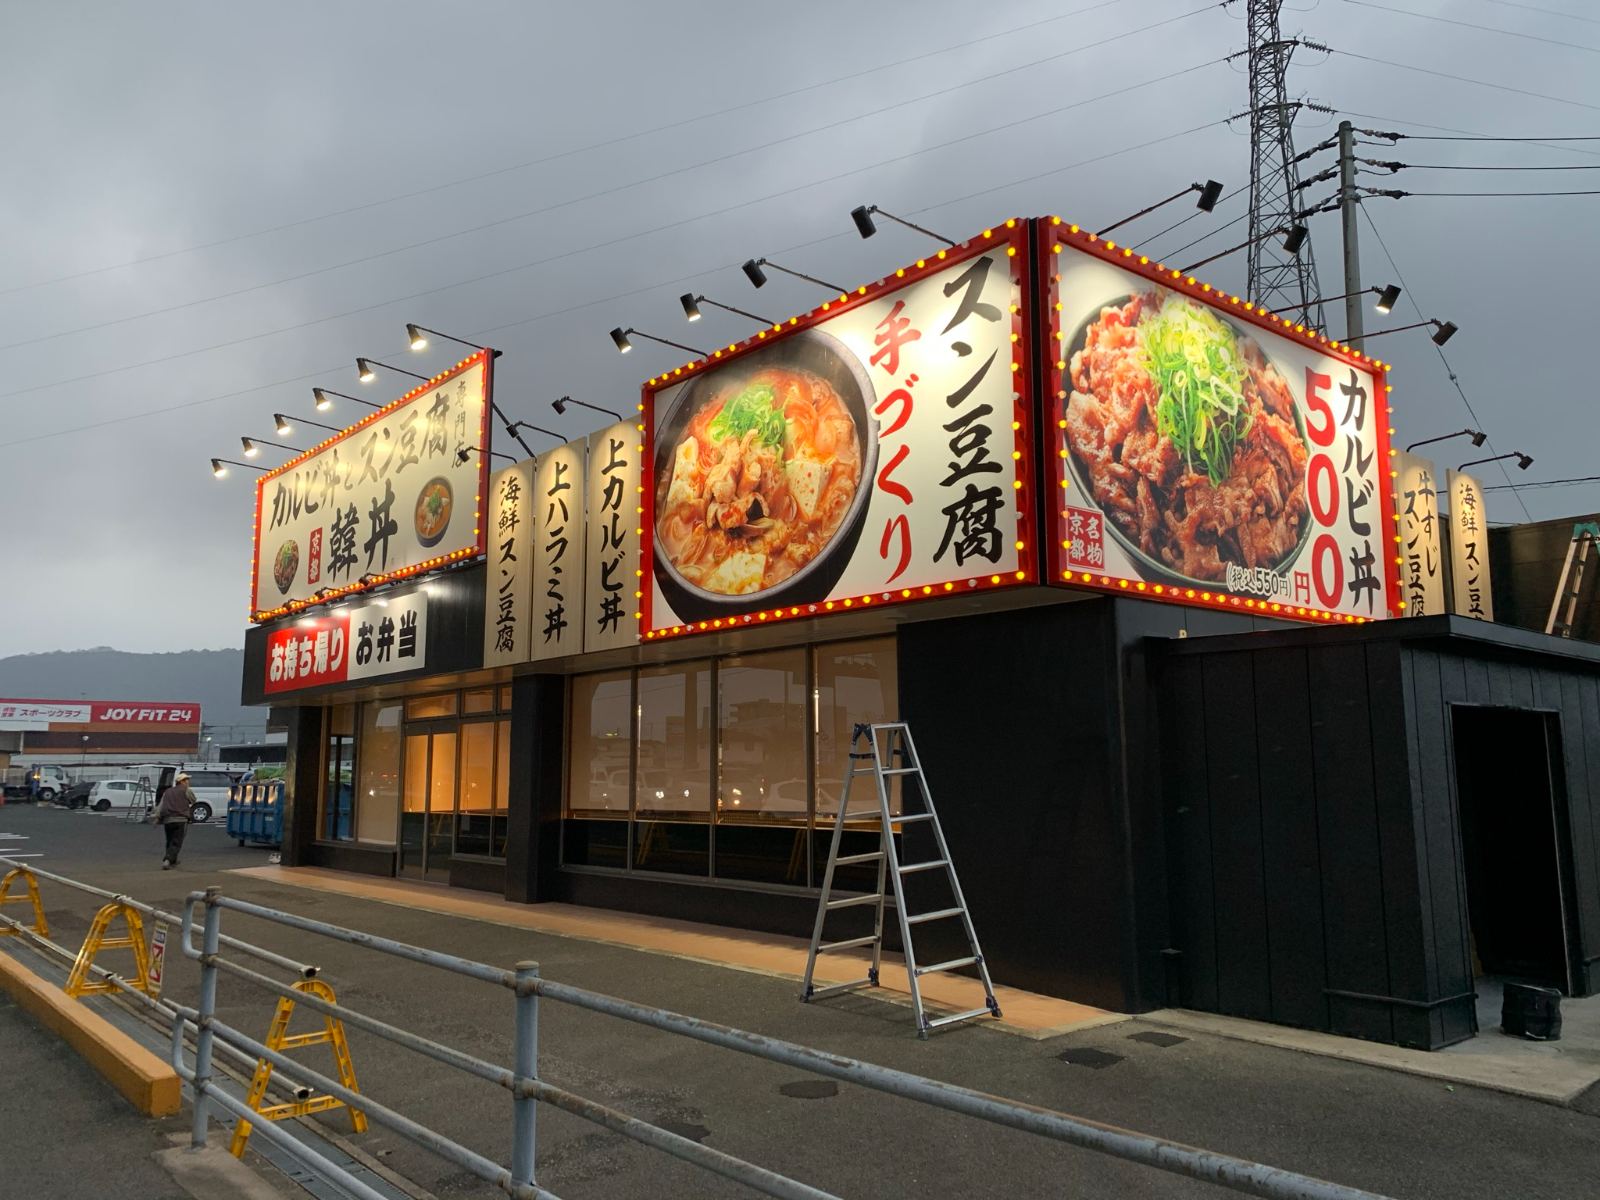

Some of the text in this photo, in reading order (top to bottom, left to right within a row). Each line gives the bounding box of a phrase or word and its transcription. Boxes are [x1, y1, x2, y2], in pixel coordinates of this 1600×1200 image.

[869, 300, 922, 584] 手づくり
[933, 256, 1005, 567] スン豆腐
[327, 478, 399, 583] 韓丼
[543, 461, 571, 645] 上ハラミ丼
[597, 438, 628, 635] 上カルビ丼
[1085, 516, 1103, 566] 名物
[1339, 368, 1381, 615] カルビ丼
[1418, 471, 1437, 578] 牛すじ
[1459, 484, 1485, 621] 海鮮スン豆
[494, 475, 522, 653] 海鮮スン豆腐
[270, 627, 345, 682] お持ち帰り
[356, 609, 418, 666] お弁当
[19, 708, 82, 718] スポーツクラブ
